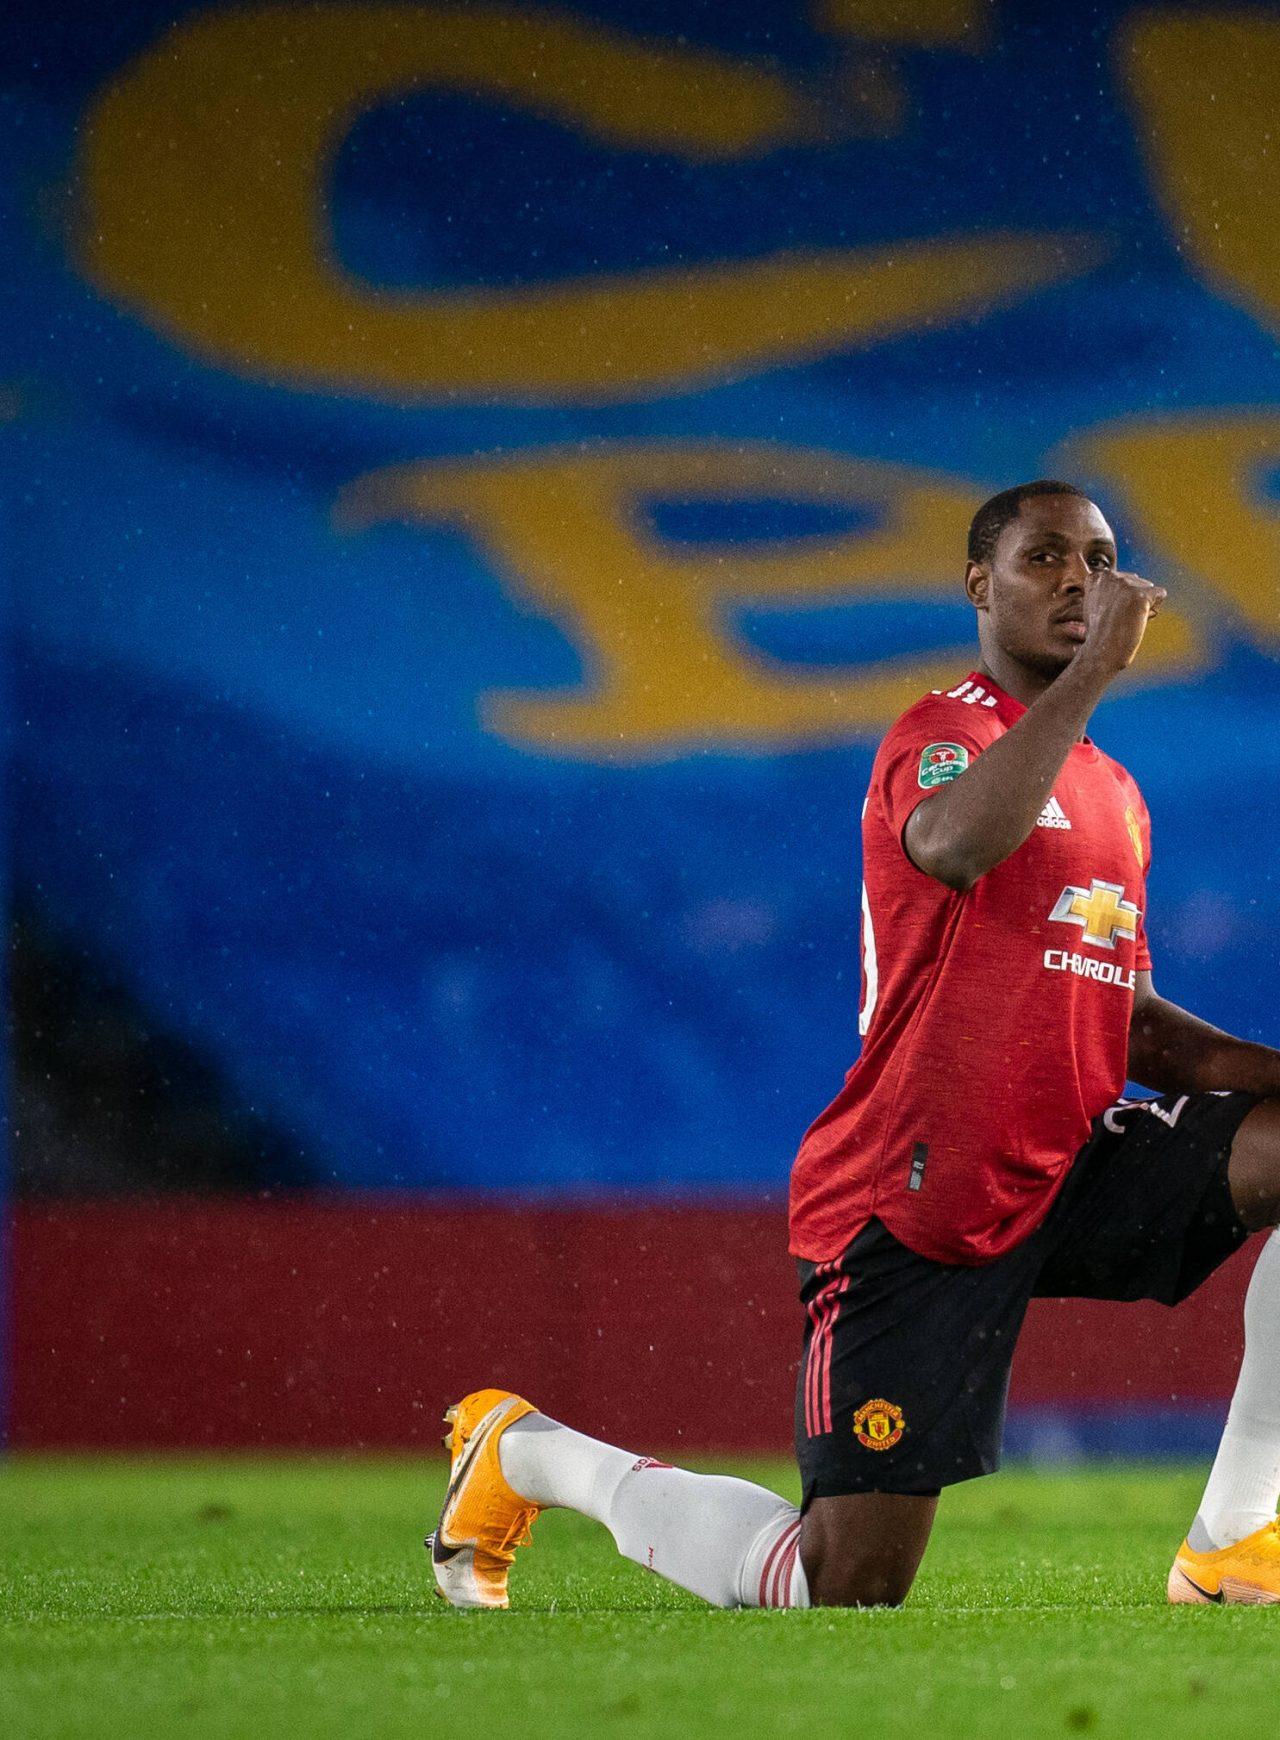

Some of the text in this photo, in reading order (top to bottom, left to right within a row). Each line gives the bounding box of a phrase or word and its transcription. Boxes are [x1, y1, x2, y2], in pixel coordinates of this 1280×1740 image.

[932, 766, 954, 775] Cup
[1036, 816, 1072, 830] adidas
[1043, 949, 1136, 991] CHVROLE
